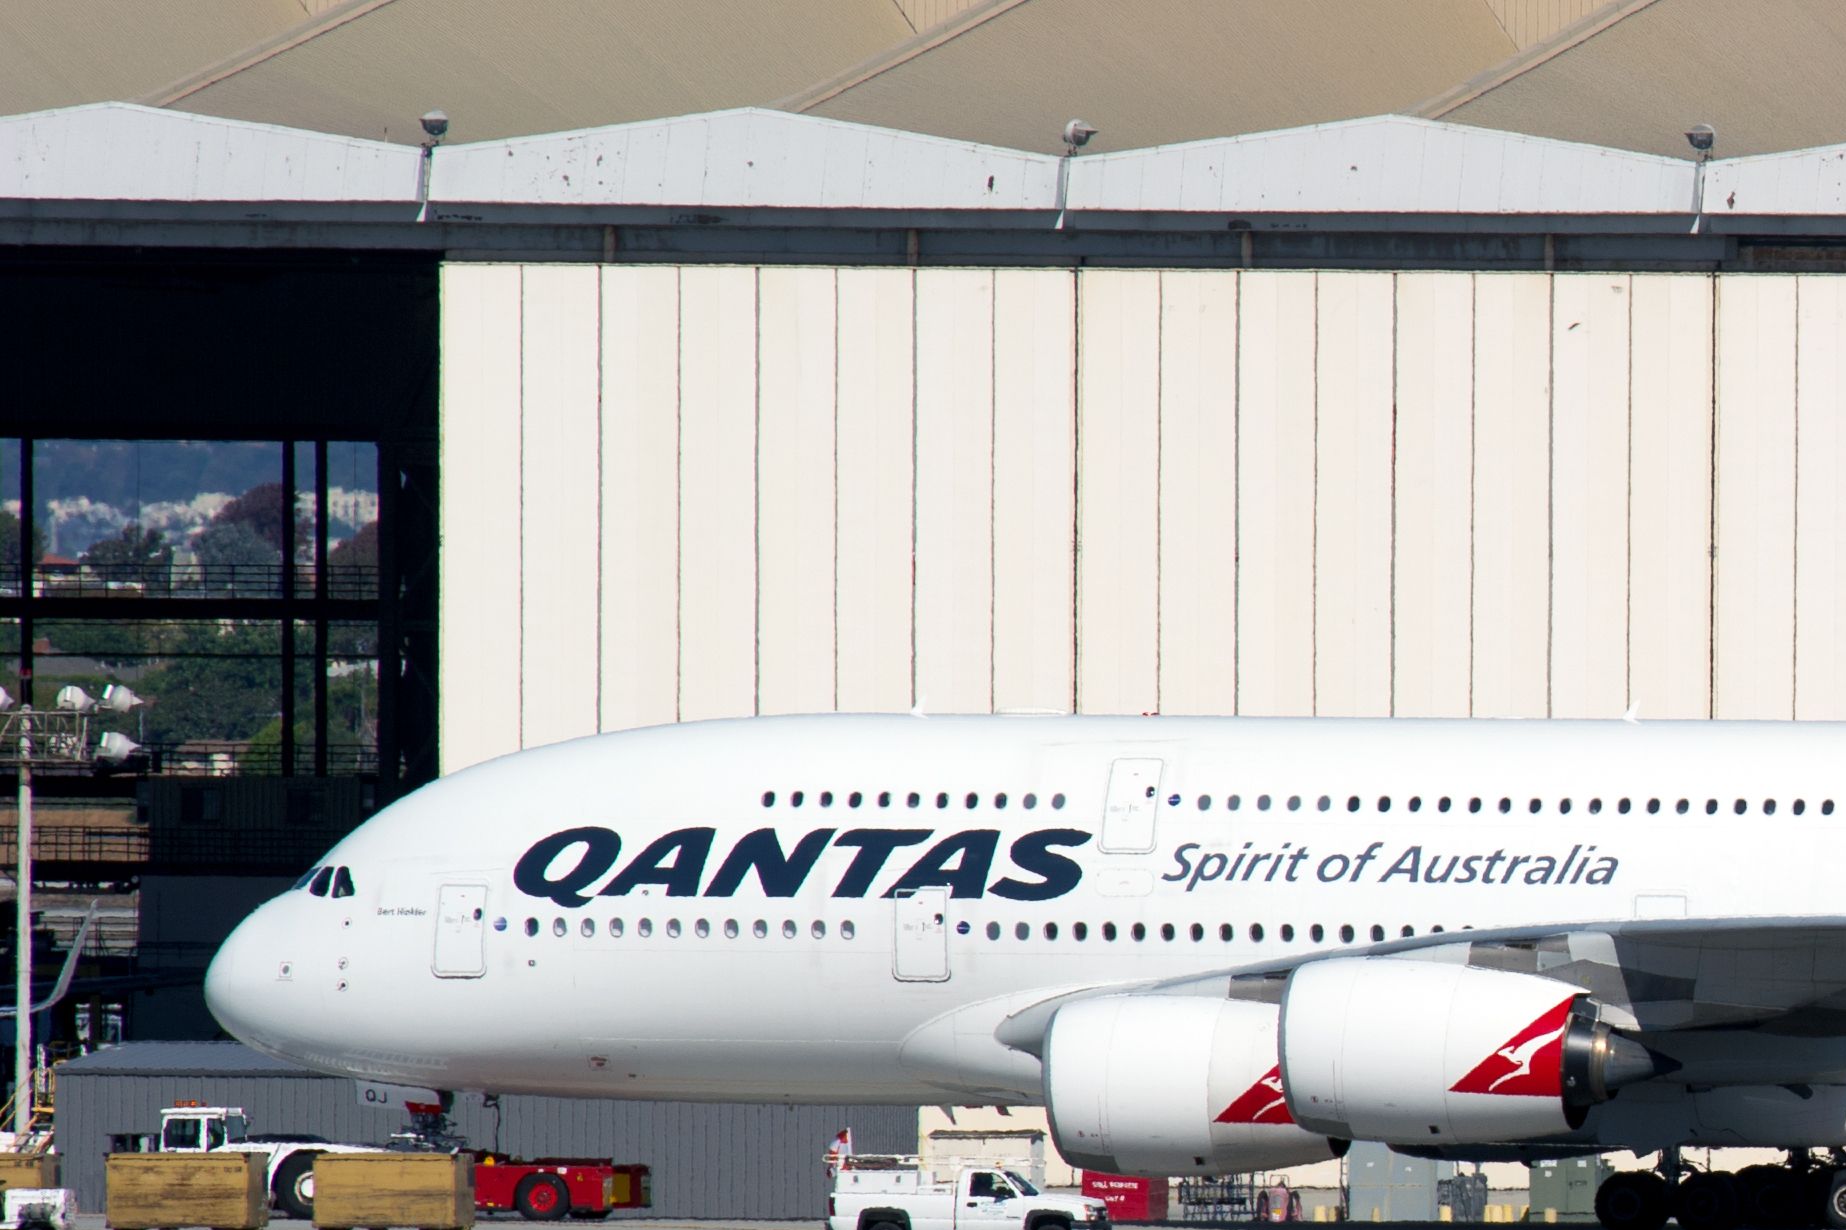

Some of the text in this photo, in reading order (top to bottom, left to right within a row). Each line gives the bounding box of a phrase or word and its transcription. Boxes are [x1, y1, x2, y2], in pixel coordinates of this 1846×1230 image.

[513, 826, 1093, 908] QANTAS
[1161, 841, 1620, 892] Spirit of Australia
[365, 1089, 388, 1104] QJ
